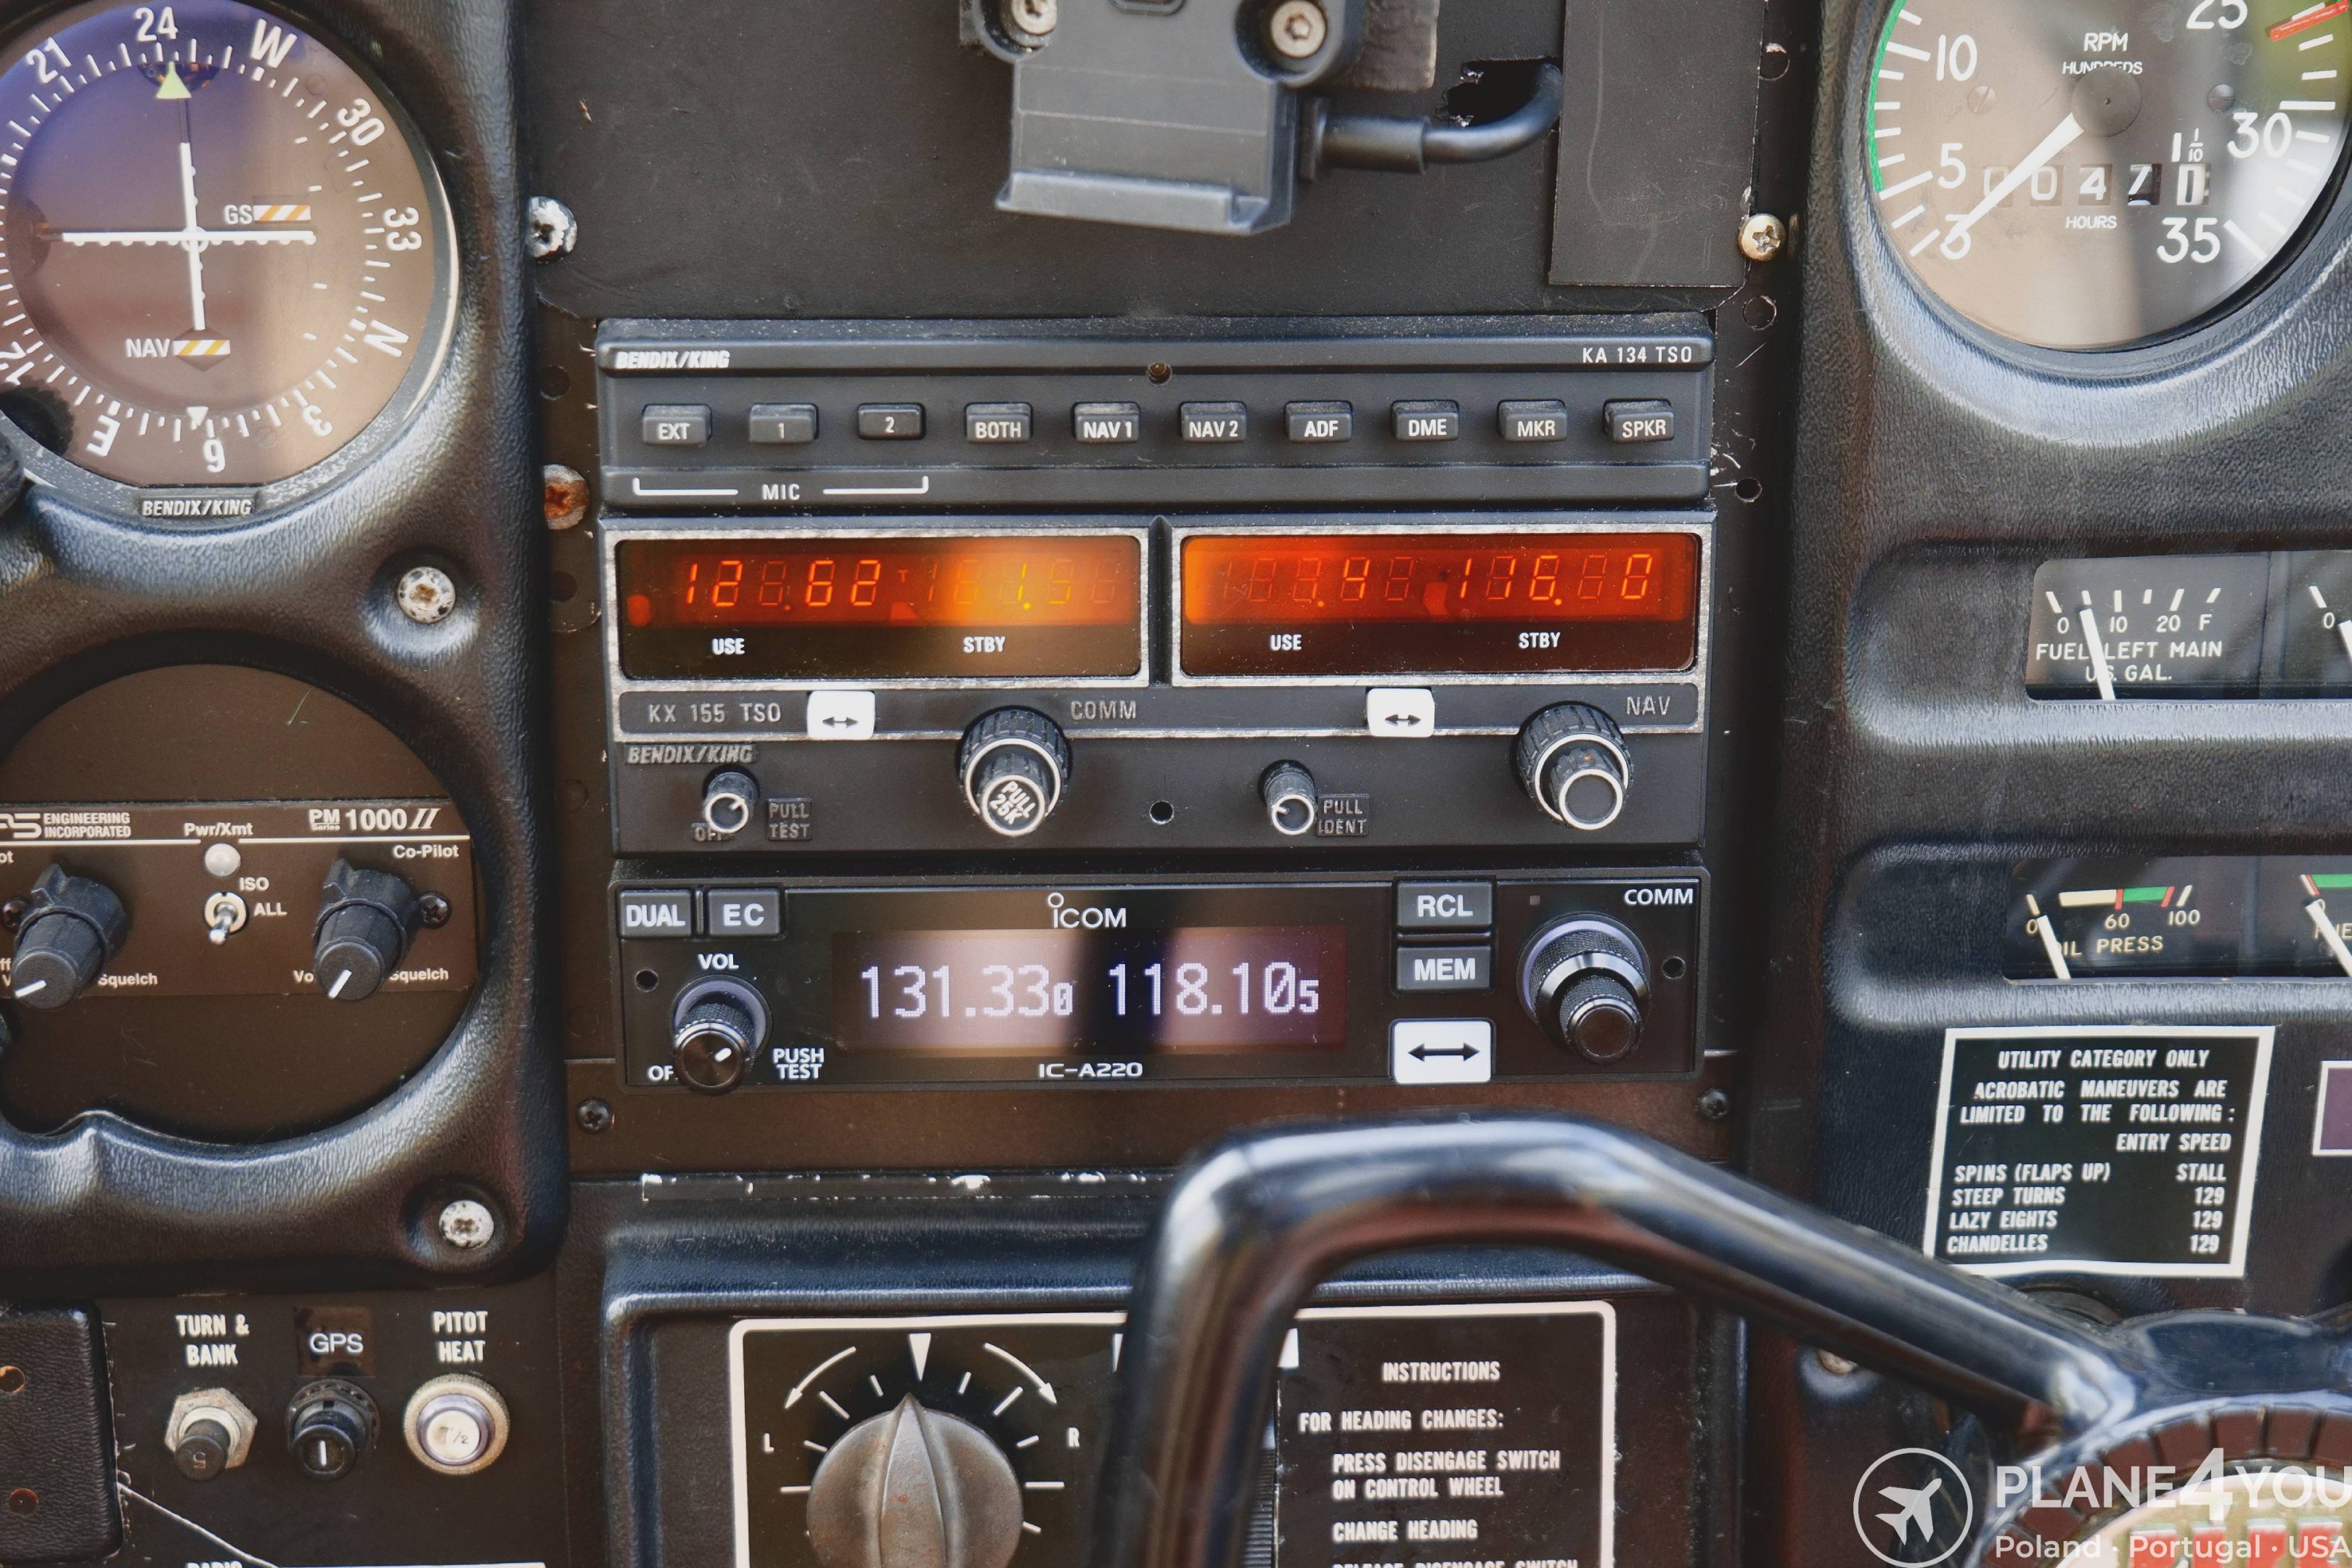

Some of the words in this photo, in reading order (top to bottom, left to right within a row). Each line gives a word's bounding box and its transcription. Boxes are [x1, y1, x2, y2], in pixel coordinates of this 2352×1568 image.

[134, 6, 179, 42] 24
[250, 18, 298, 68] W
[2083, 31, 2128, 52] RPM
[27, 37, 72, 83] 21
[1936, 34, 1977, 82] 10
[338, 98, 385, 147] 30
[2226, 112, 2292, 159] 30
[1937, 142, 1967, 189] 5
[223, 203, 253, 224] GS
[2064, 215, 2118, 229] HOURS
[383, 207, 422, 251] 33
[2157, 216, 2221, 264] 35
[125, 338, 171, 359] NAV
[364, 319, 409, 358] N
[614, 349, 731, 369] BENDIX/KING
[1583, 346, 1608, 364] KA
[1617, 346, 1647, 363] 134
[1654, 346, 1692, 364] TSO
[303, 404, 333, 437] 3
[777, 422, 785, 439] 1
[885, 416, 895, 433] 2
[975, 421, 1021, 439] BOTH
[1082, 421, 1119, 439] NAV
[1124, 421, 1132, 438] 1
[1188, 420, 1225, 438] NAV
[1228, 421, 1239, 438] 2
[1304, 420, 1339, 438] ADF
[1408, 418, 1447, 437] DME
[1517, 419, 1556, 437] MKR
[1622, 419, 1666, 438] SPKR
[86, 414, 121, 457] E
[657, 422, 691, 441] EXT
[761, 483, 800, 501] MIC
[142, 498, 252, 517] BENDIX/KING
[2057, 616, 2069, 634] 0
[2109, 616, 2128, 634] 10
[2155, 614, 2181, 633] 20
[2199, 613, 2213, 632] F
[2323, 612, 2335, 629] 0
[712, 637, 746, 656] USE
[963, 636, 1006, 653] STBY
[1270, 634, 1302, 651] USE
[1519, 632, 1561, 649] STBY
[2035, 642, 2091, 661] FUEL
[2104, 641, 2159, 660] LEFT
[2169, 640, 2223, 658] MAIN
[2124, 663, 2173, 682] GAL.
[648, 704, 678, 723] KX
[689, 704, 726, 723] 155
[738, 703, 782, 723] TSO
[1070, 701, 1138, 721] COMM
[1625, 695, 1672, 716] NAV
[626, 745, 754, 764] BENDIX/KING
[989, 793, 1023, 825] 25K
[1000, 780, 1037, 819] PULL
[1323, 799, 1363, 815] PULL
[43, 812, 131, 825] ENGINEERING
[309, 808, 341, 824] PM
[345, 808, 408, 830] 1000
[769, 803, 810, 819] PULL
[44, 825, 132, 839] INCORPORATED
[184, 822, 254, 837] Pwr/Xmt
[311, 823, 341, 832] Series
[693, 825, 723, 842] OF
[769, 822, 810, 839] TEST
[1318, 818, 1368, 835] IDENT
[393, 844, 460, 859] Co-Pilot
[239, 876, 269, 892] ISO
[1416, 894, 1474, 918] RCL
[1624, 889, 1694, 907] COMM
[253, 902, 287, 917] ALL
[626, 905, 686, 927] DUAL
[722, 904, 766, 926] EC
[2025, 918, 2038, 934] 0
[2104, 912, 2130, 929] 60
[2168, 908, 2201, 926] 100
[2096, 934, 2164, 954] PRESS
[698, 953, 740, 971] VOL
[1413, 957, 1477, 981] MEM
[97, 972, 158, 987] Squelch
[293, 969, 314, 983] Vo
[389, 967, 449, 984] Squelch
[862, 965, 1074, 1018] 131.330
[1108, 961, 1319, 1016] 118.105
[772, 1048, 825, 1064] PUSH
[1998, 1050, 2062, 1069] UTILITY
[2070, 1049, 2157, 1069] CATEGORY
[2165, 1049, 2210, 1068] ONLY
[648, 1064, 679, 1082] OF
[777, 1063, 823, 1081] TEST
[1038, 1062, 1145, 1079] IC-A220
[1974, 1079, 2065, 1100] ACROBATIC
[2080, 1079, 2180, 1098] MANEUVERS
[2194, 1079, 2228, 1098] ARE
[1960, 1105, 2025, 1124] LIMITED
[2042, 1104, 2064, 1123] TO
[2081, 1103, 2112, 1122] THE
[2116, 1132, 2171, 1151] ENTRY
[2179, 1132, 2231, 1152] SPEED
[1954, 1164, 2008, 1183] SPINS
[2014, 1162, 2073, 1183] (FLAPS
[2081, 1161, 2110, 1182] UP)
[2176, 1162, 2226, 1182] STALL
[1952, 1187, 2004, 1206] STEEP
[2013, 1186, 2066, 1205] TURNS
[2194, 1186, 2225, 1206] 129
[1949, 1211, 1991, 1230] LAZY
[1999, 1209, 2058, 1230] EIGHTS
[2193, 1210, 2224, 1230] 129
[1947, 1233, 2049, 1254] CHANDELLES
[2190, 1234, 2220, 1254] 129
[176, 1314, 226, 1337] TURN
[235, 1315, 250, 1335] &
[433, 1311, 488, 1334] PITOT
[309, 1333, 364, 1354] GPS
[438, 1340, 486, 1363] HEAT
[187, 1343, 239, 1366] BANK
[1382, 1360, 1500, 1382] INSTRUCTIONS
[1299, 1411, 1332, 1433] FOR
[1341, 1410, 1412, 1431] HEADING
[1421, 1408, 1503, 1430] CHANGES:
[764, 1432, 775, 1453] L
[1068, 1427, 1080, 1447] R
[1332, 1452, 1387, 1474] PRESS
[1395, 1450, 1487, 1472] DISENGAGE
[1496, 1450, 1560, 1471] SWITCH
[1332, 1479, 1356, 1500] ON
[1364, 1477, 1439, 1500] CONTROL
[1448, 1476, 1504, 1497] WHEEL
[1332, 1520, 1398, 1543] CHANGE
[1407, 1519, 1478, 1540] HEADING
